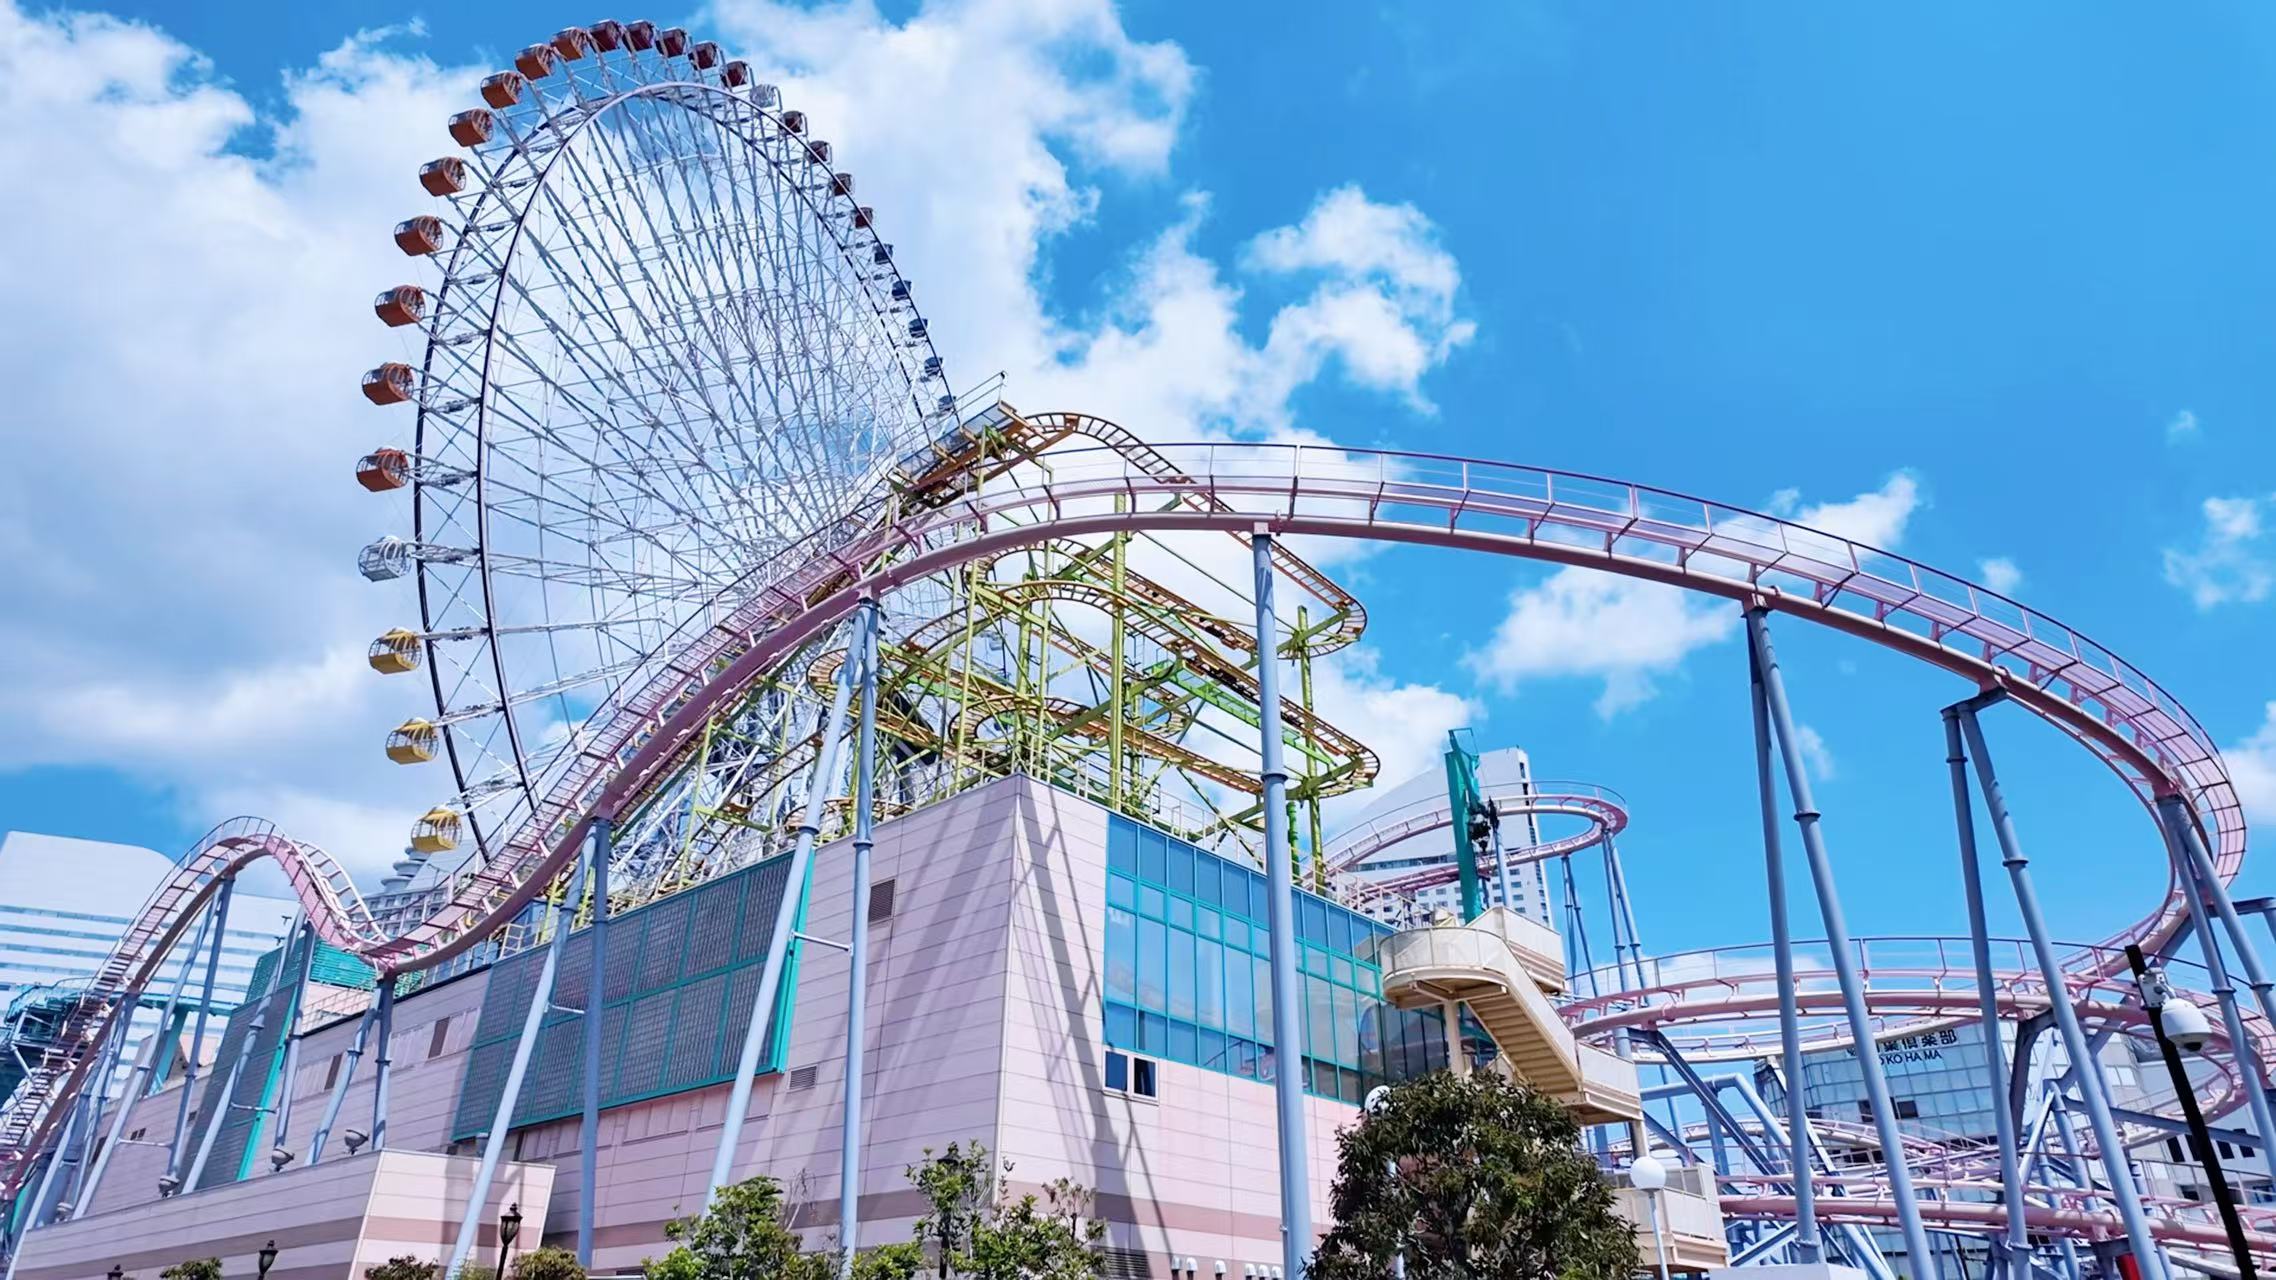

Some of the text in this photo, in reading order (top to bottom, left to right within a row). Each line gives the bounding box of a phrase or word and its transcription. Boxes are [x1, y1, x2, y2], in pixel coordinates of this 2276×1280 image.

[1875, 1029, 1957, 1053] 葉倶楽部
[1880, 1050, 1942, 1065] KOHAMA
